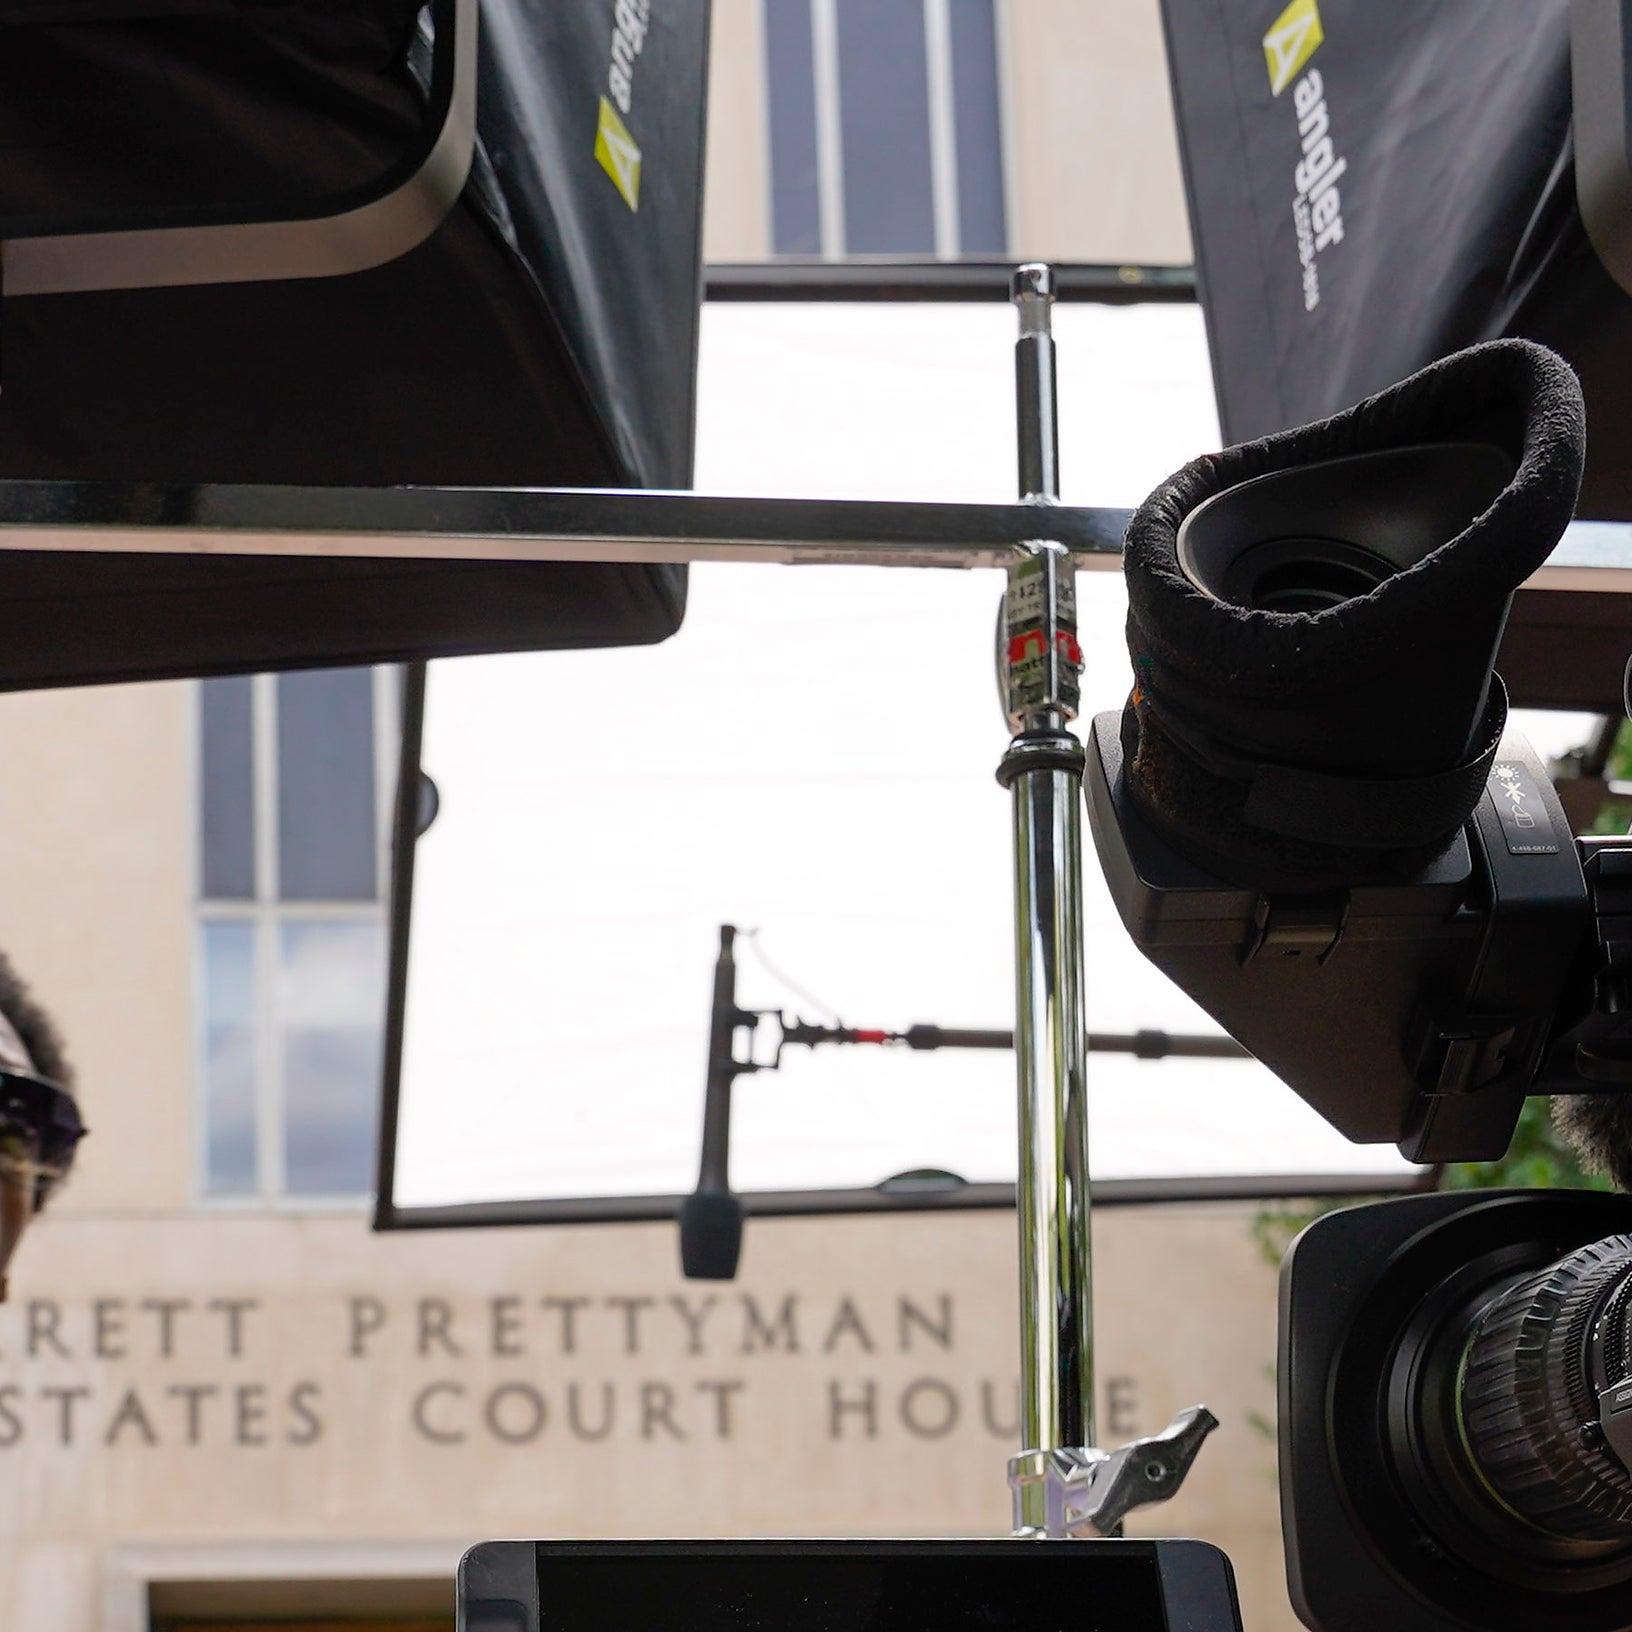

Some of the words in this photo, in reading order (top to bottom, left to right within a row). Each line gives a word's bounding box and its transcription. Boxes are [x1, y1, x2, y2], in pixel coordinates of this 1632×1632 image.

[1294, 67, 1347, 252] angler
[347, 1293, 955, 1359] PRETTYMAN
[411, 1379, 745, 1446] COURT
[827, 1377, 1139, 1440] HOUE
